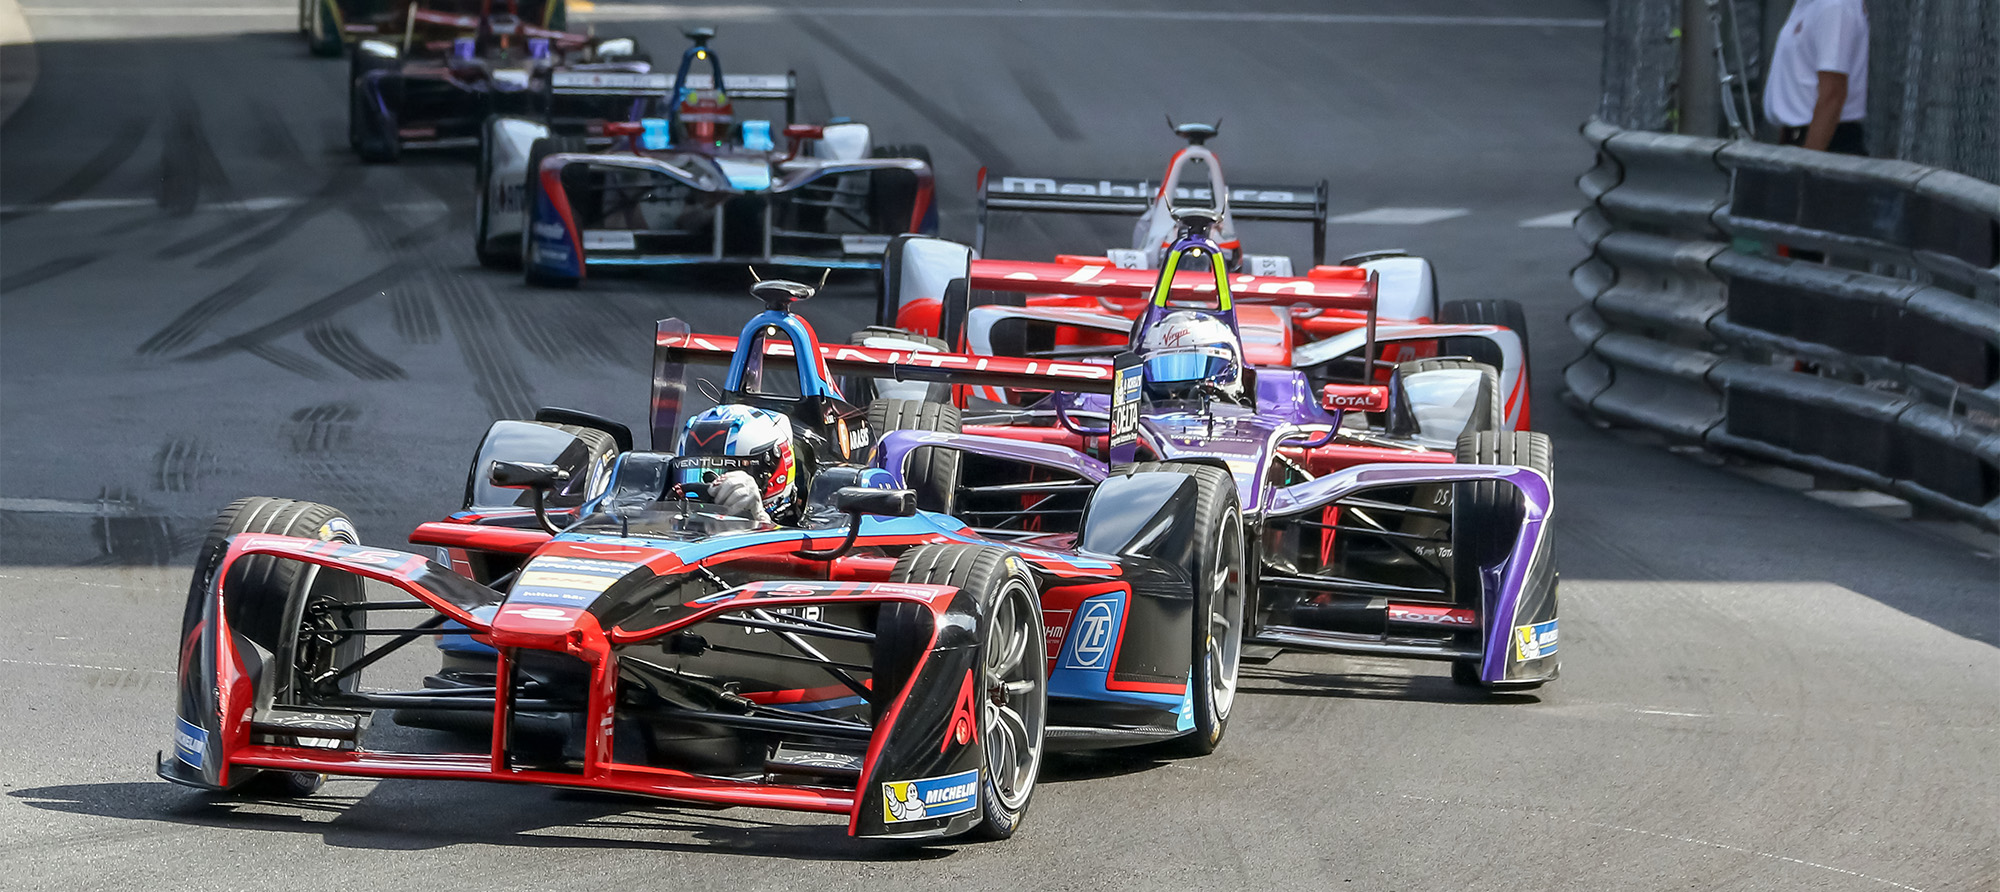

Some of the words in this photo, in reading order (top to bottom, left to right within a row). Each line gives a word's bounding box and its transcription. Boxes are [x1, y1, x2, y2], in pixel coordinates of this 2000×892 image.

[1162, 326, 1190, 347] Virgin
[1326, 393, 1375, 406] TOTAL
[1116, 402, 1138, 435] DELTA
[674, 459, 742, 468] VENTURI
[1389, 609, 1472, 624] TOTAL
[1077, 616, 1112, 652] ZF
[926, 781, 977, 804] MICHELIN
